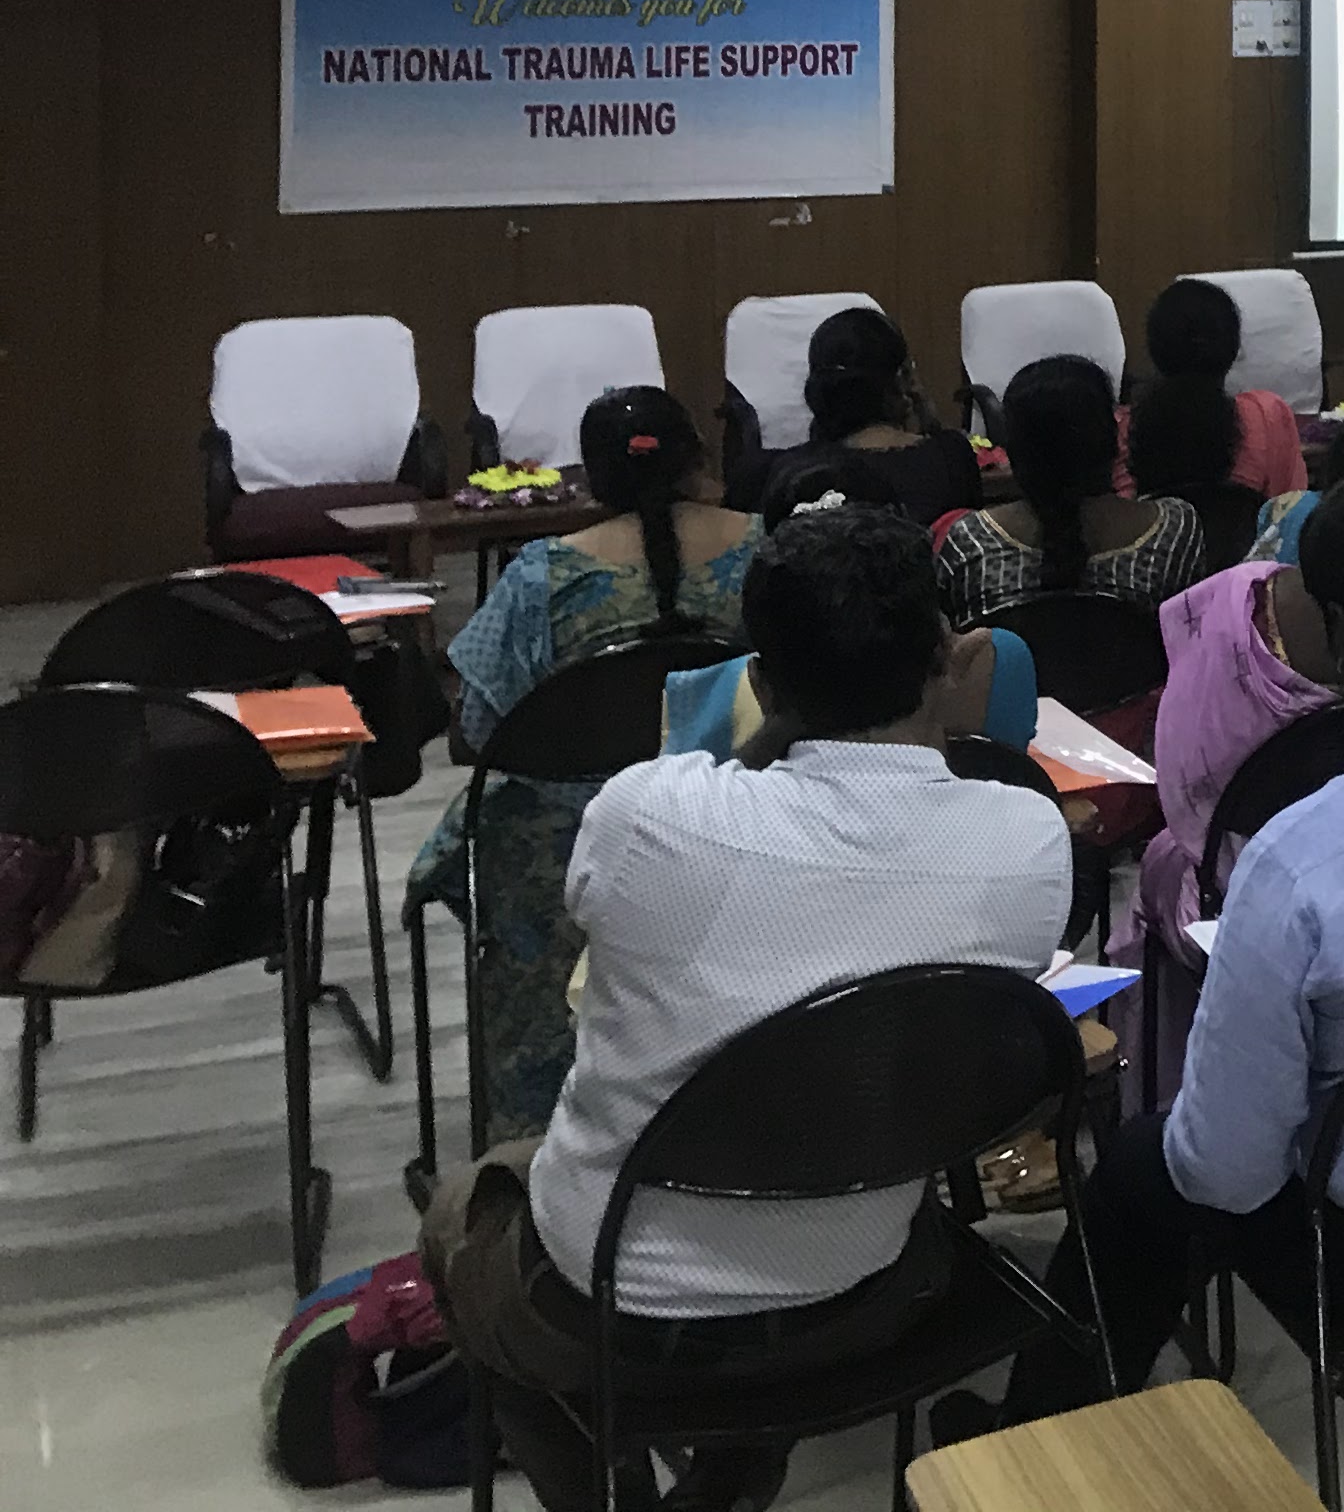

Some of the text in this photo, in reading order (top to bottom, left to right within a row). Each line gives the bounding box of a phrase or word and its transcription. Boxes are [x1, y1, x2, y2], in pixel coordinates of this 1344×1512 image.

[322, 43, 859, 84] NATIONAL TRAUMA LIFE SUPPORT
[524, 102, 677, 138] TRAINING
